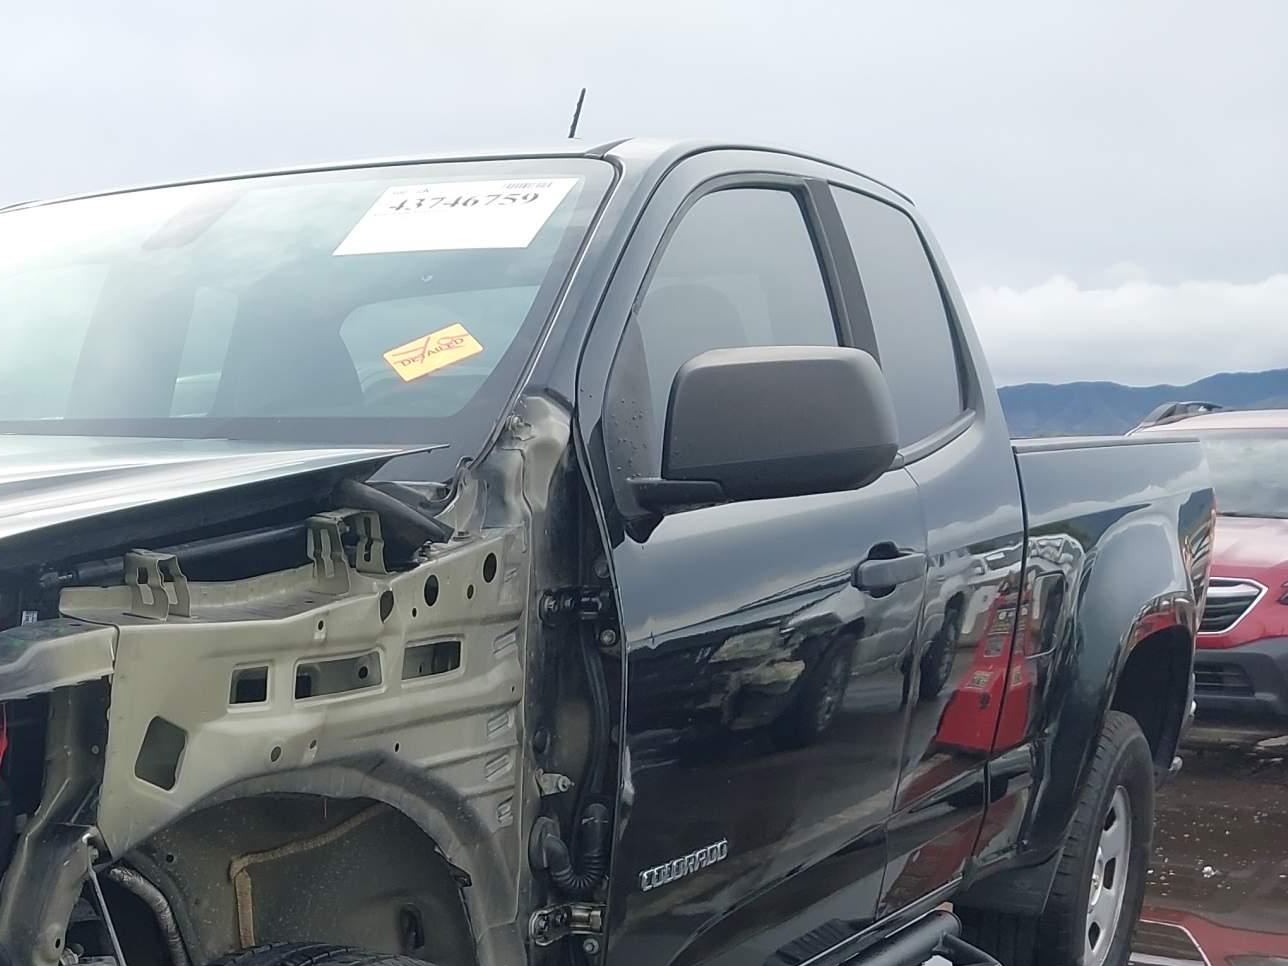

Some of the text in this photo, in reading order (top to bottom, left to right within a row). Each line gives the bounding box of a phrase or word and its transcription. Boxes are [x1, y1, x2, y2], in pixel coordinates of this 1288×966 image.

[389, 192, 539, 212] 43746759
[400, 336, 465, 367] DETAILED
[639, 838, 729, 892] COLORADO
